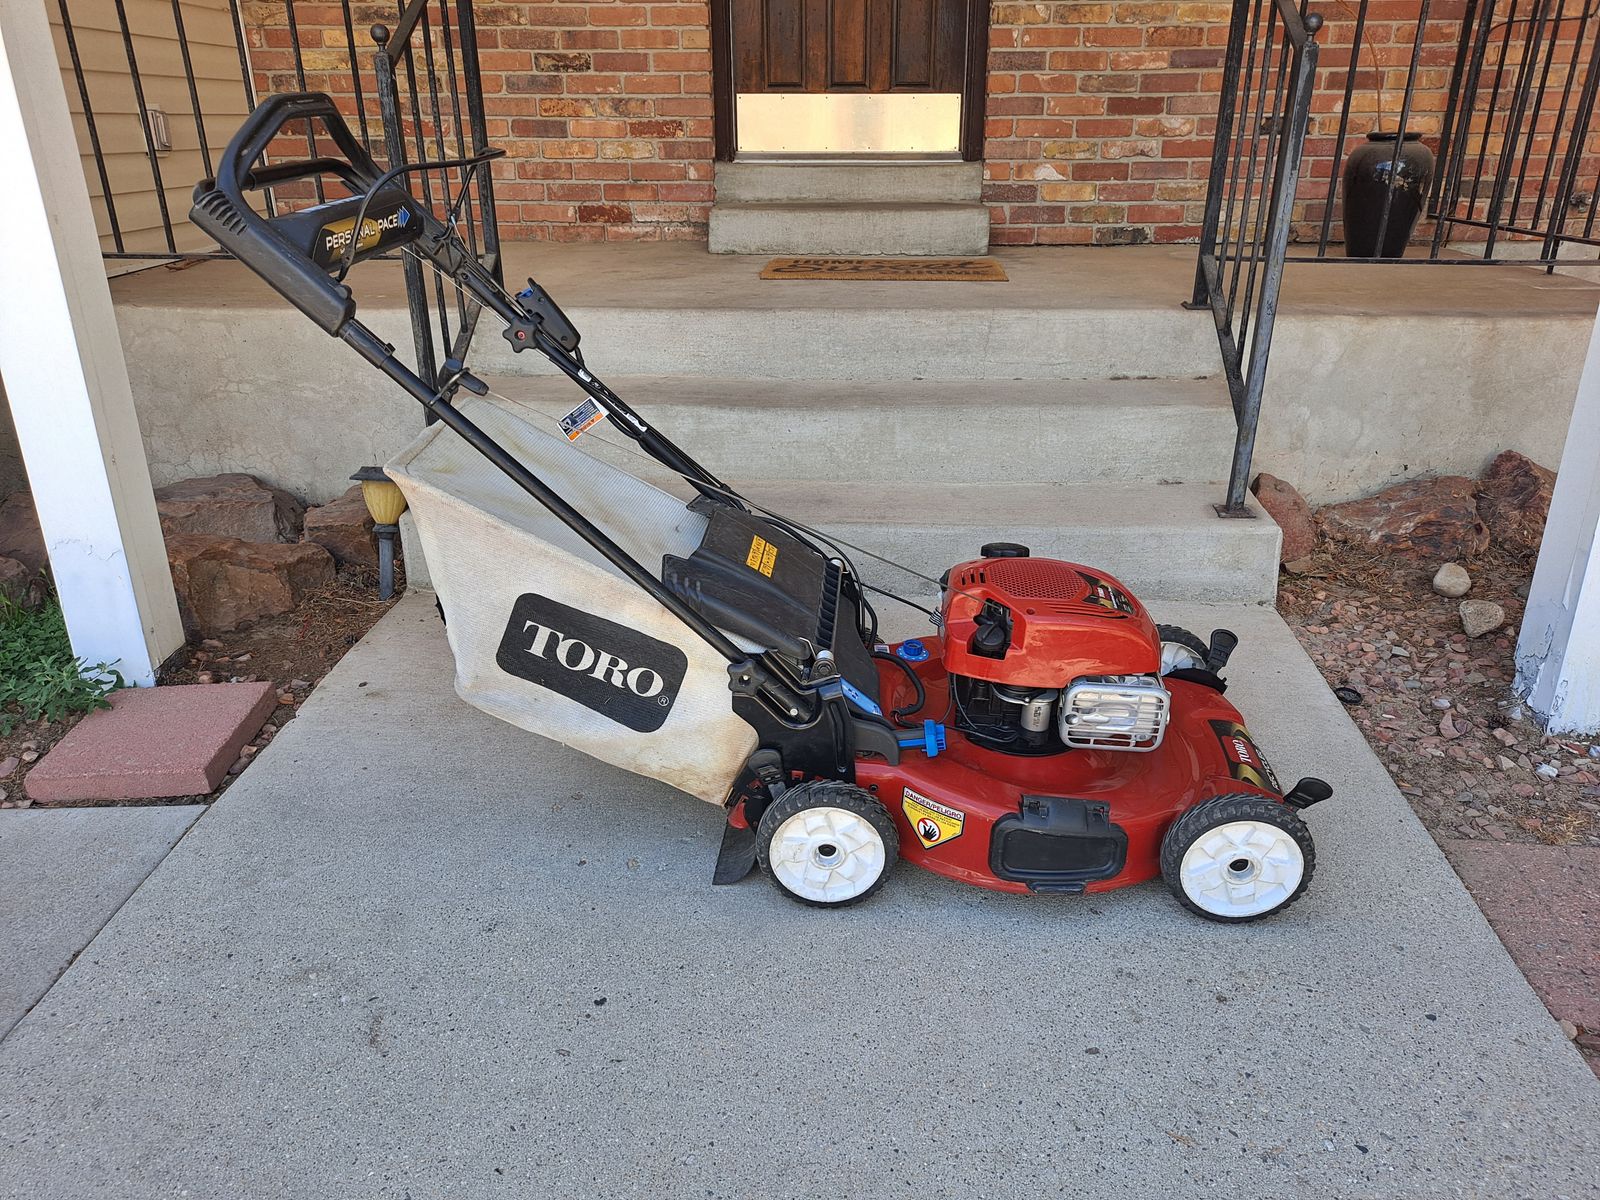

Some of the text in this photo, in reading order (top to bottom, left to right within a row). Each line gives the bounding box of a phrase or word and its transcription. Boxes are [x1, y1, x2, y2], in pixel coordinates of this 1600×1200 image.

[325, 223, 375, 251] PERSNAL
[377, 213, 398, 232] PACE
[522, 619, 665, 698] TORO
[1232, 739, 1253, 763] TORO
